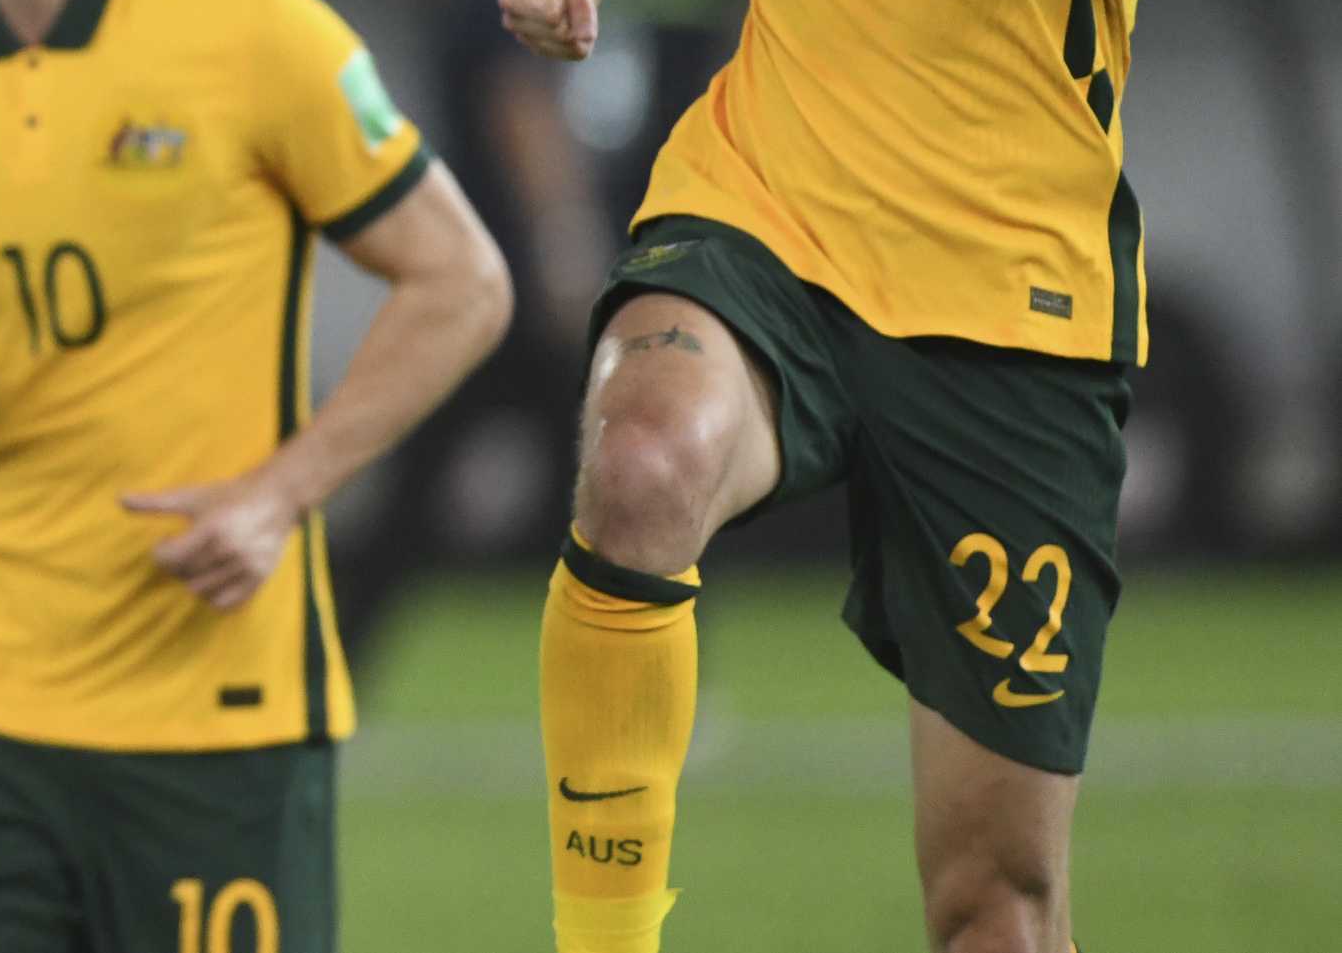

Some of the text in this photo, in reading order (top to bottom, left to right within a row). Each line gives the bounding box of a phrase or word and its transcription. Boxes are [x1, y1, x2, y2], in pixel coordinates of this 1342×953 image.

[1, 240, 107, 354] 10
[949, 532, 1072, 673] 22
[566, 830, 643, 866] AUS
[170, 877, 279, 953] 10
